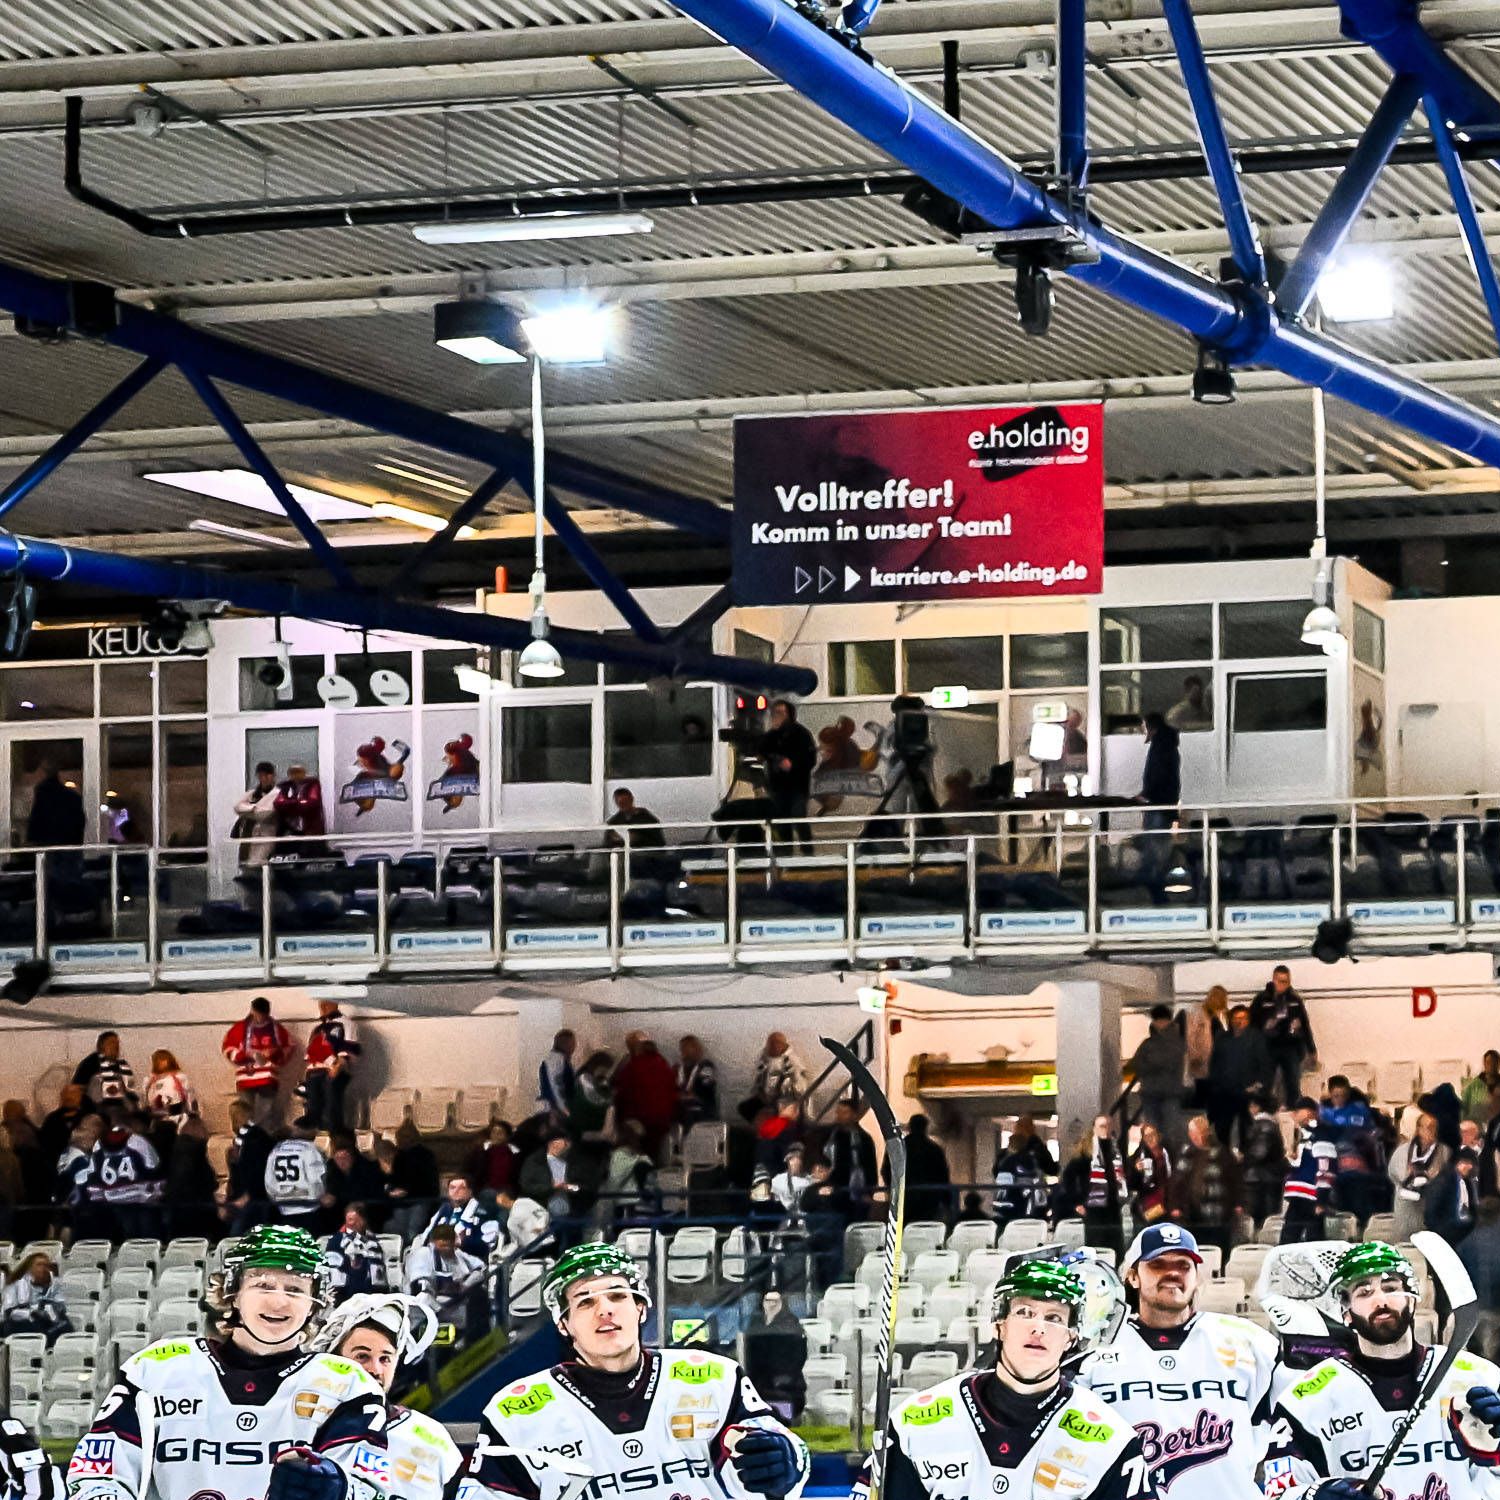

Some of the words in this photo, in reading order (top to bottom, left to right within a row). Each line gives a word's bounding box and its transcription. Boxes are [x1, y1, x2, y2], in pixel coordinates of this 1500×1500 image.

[968, 422, 1089, 453] e.holding
[775, 480, 954, 512] Volltreffer!
[752, 522, 830, 545] Komm
[837, 519, 858, 541] in
[866, 520, 933, 541] unser
[938, 514, 1012, 538] Team!
[871, 559, 1088, 586] karriere.e-holding.de
[1413, 987, 1437, 1018] D
[273, 1154, 300, 1184] 55
[671, 1361, 724, 1381] Karls
[1098, 1351, 1121, 1365] ber
[501, 1386, 553, 1416] Karls
[902, 1400, 952, 1426] Karls
[1062, 1411, 1109, 1443] Karls
[1136, 1408, 1234, 1460] Berlin
[918, 1458, 968, 1482] Uber
